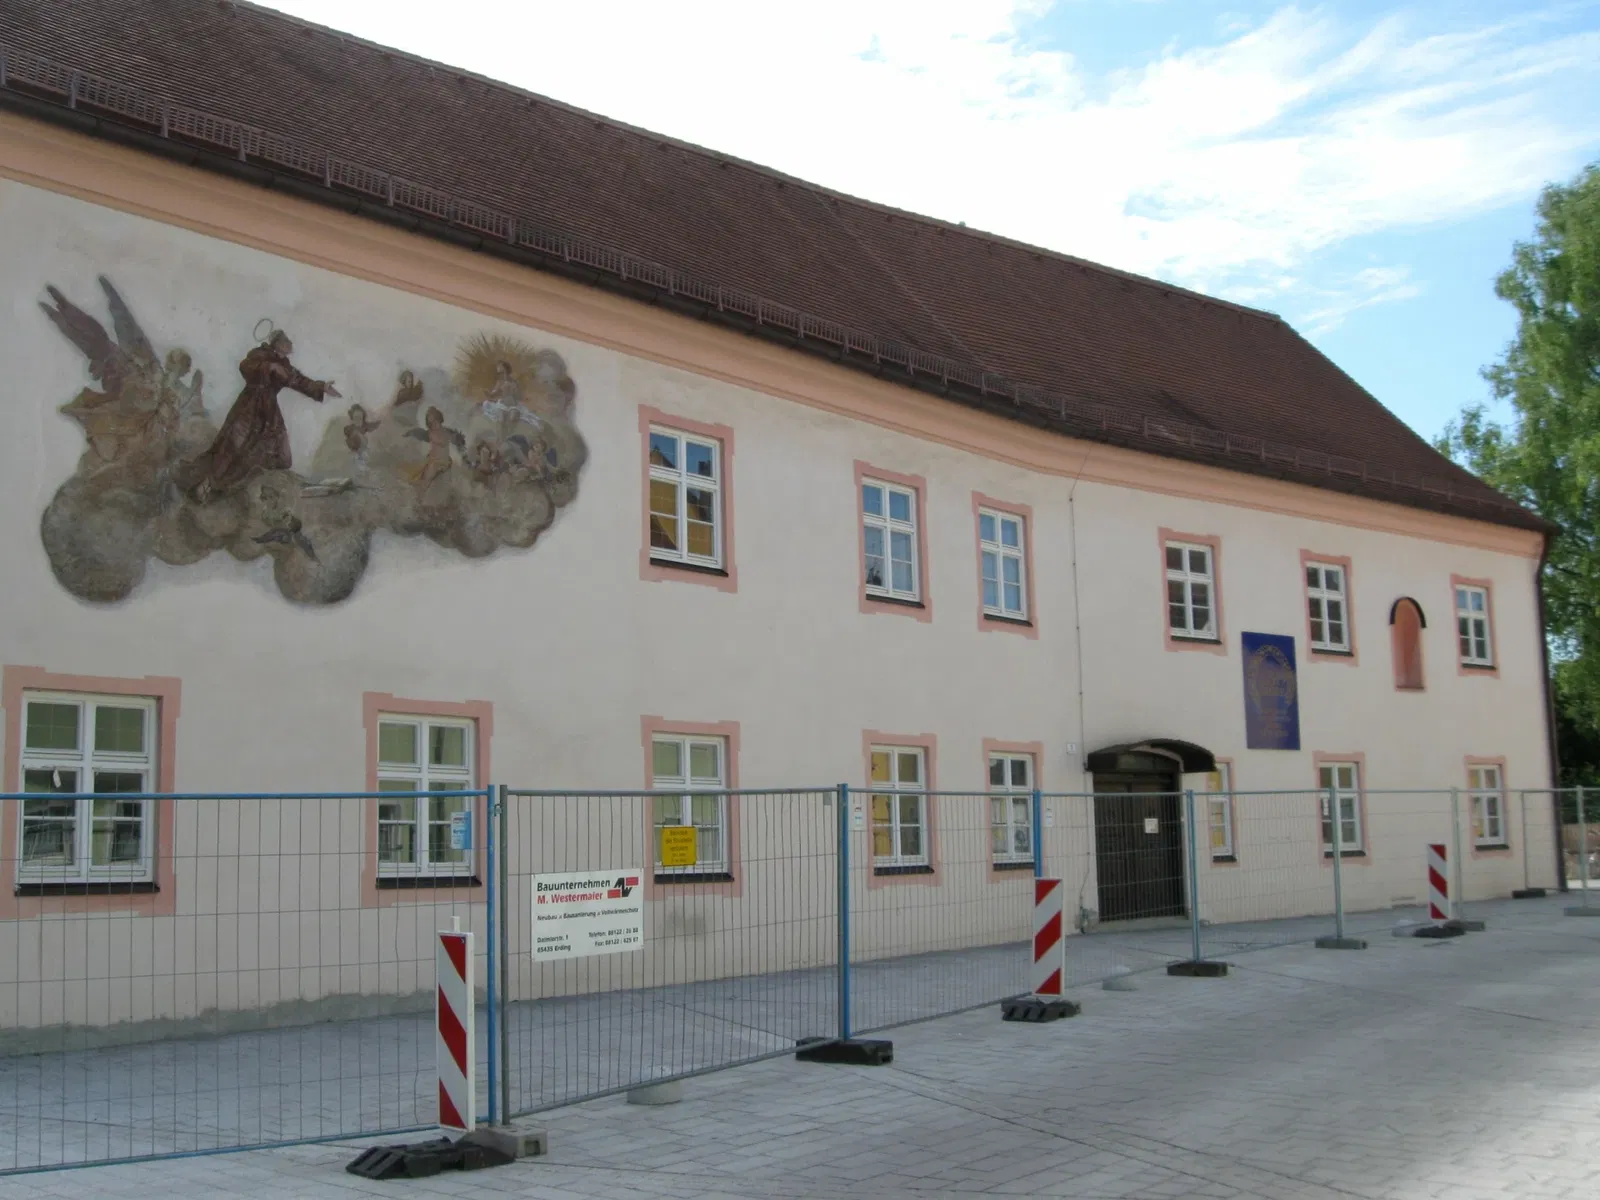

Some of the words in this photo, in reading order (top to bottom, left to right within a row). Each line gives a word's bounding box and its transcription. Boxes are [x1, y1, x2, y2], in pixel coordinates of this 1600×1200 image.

[536, 879, 611, 892] Bauunternehmen
[537, 894, 549, 905] M.
[551, 891, 603, 904] Westermaier
[554, 944, 571, 953] Erding
